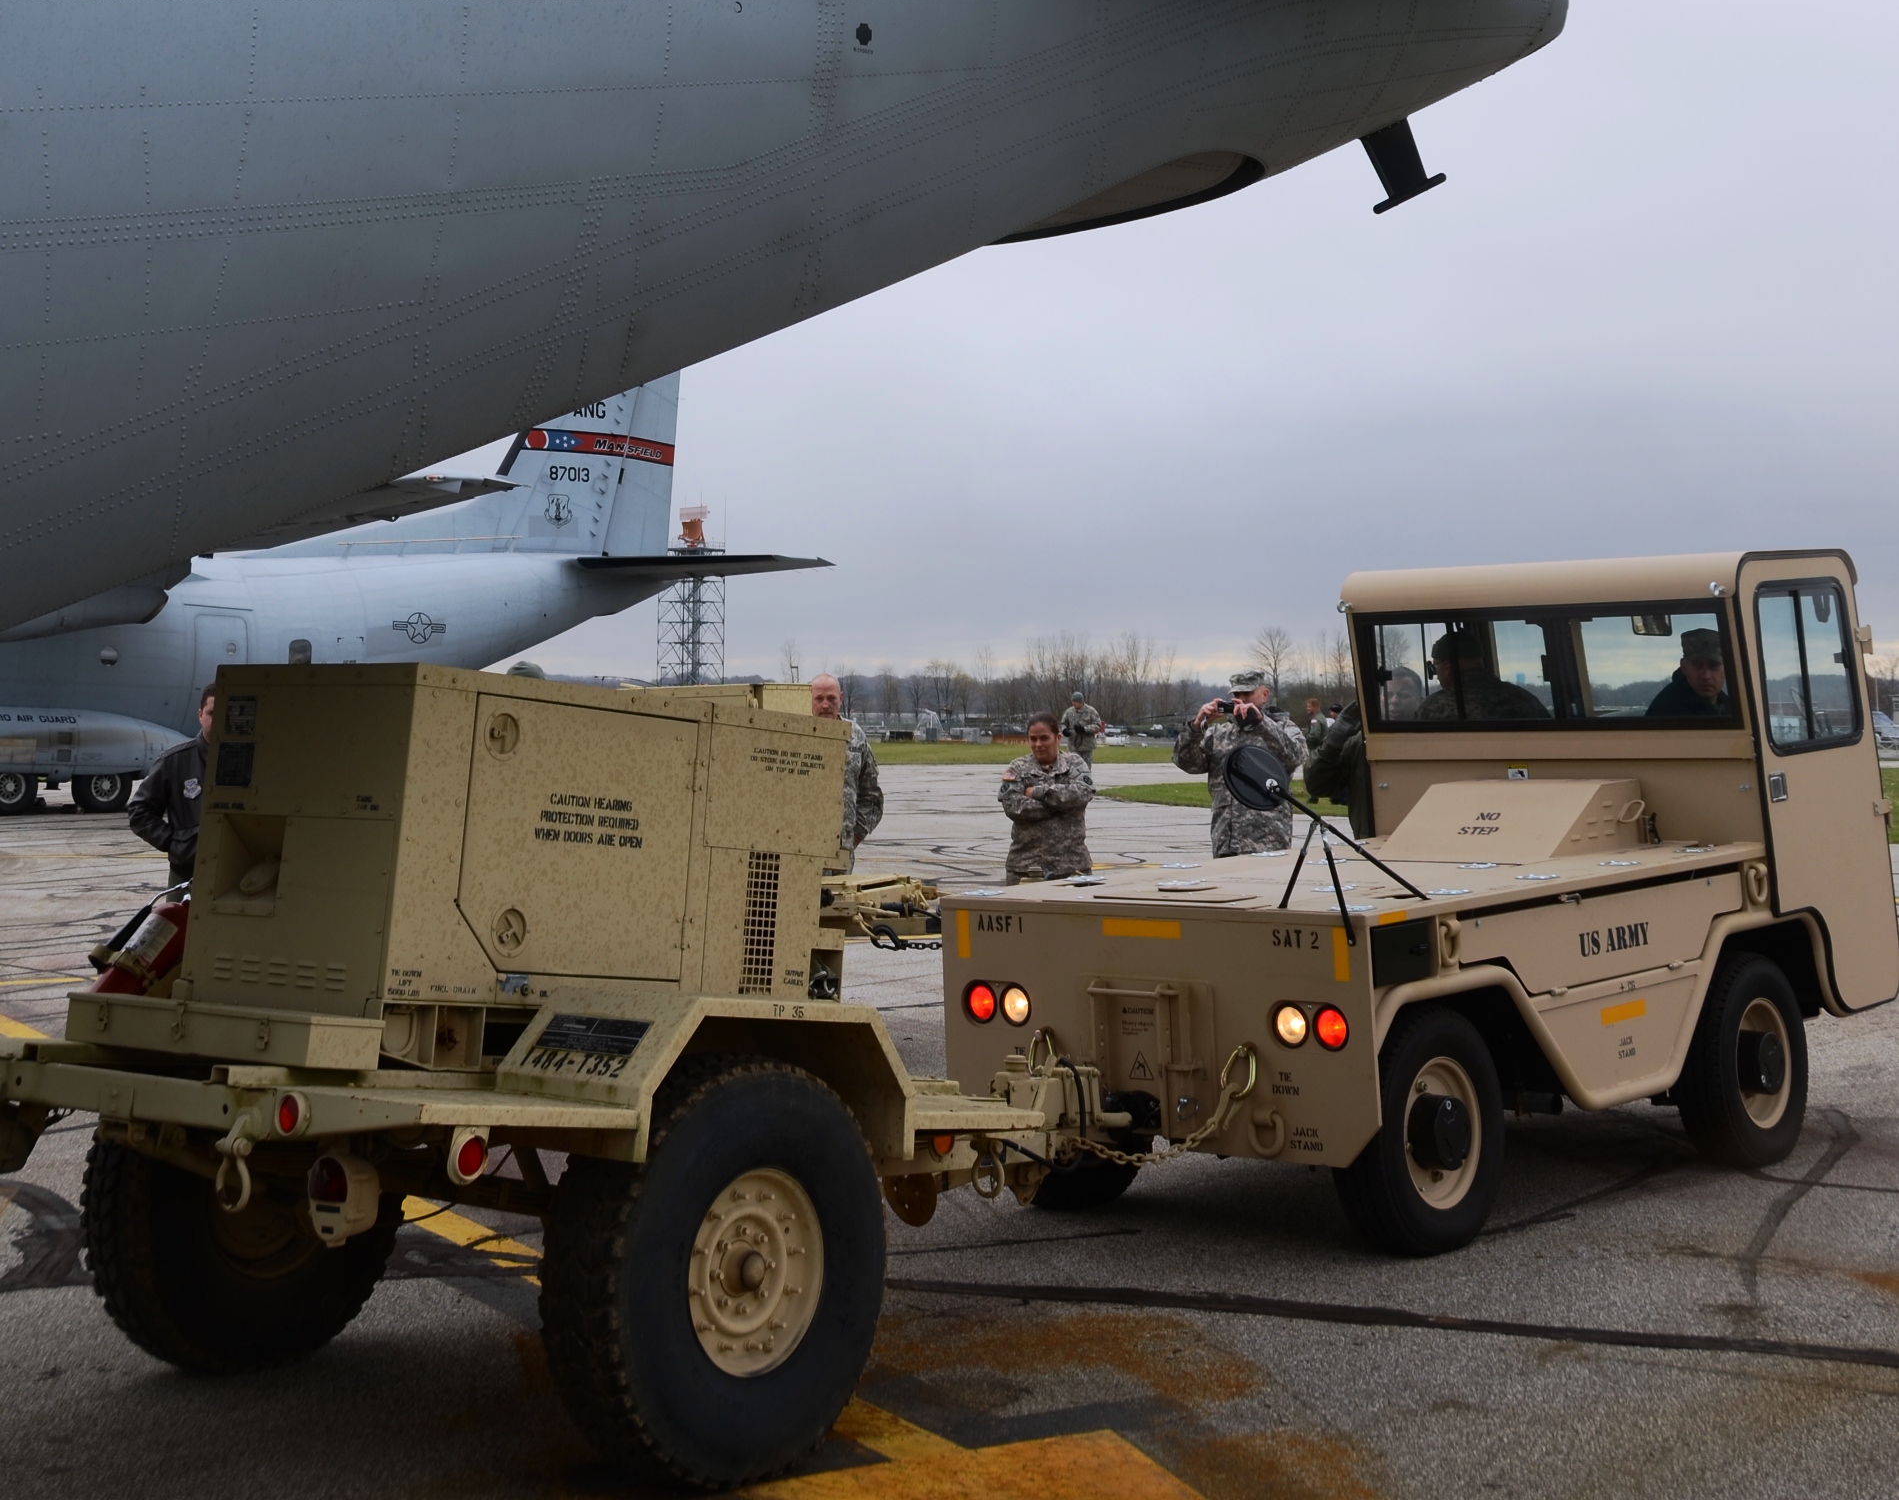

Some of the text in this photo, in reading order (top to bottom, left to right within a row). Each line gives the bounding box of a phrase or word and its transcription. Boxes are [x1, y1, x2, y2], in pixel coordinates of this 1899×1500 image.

[573, 401, 606, 419] ANG
[549, 465, 590, 483] 87013
[17, 714, 35, 723] AIR
[39, 715, 77, 724] GUARD
[753, 747, 779, 756] CAUTION
[803, 753, 823, 761] STAND
[779, 759, 798, 767] HEAVY
[550, 793, 633, 812] CAUTION HEARING
[540, 810, 639, 831] PROTECTION REQUIRED
[1475, 812, 1501, 821] NO
[1457, 826, 1500, 836] STEP
[534, 827, 643, 849] WHEN DOORS ARE OPEN
[978, 913, 1012, 933] AASF
[1272, 929, 1319, 950] SAT 2
[1578, 921, 1649, 957] US ARMY
[402, 969, 422, 978] DOWN
[430, 984, 477, 995] FUEL DRAIN
[773, 1003, 785, 1017] TP
[1127, 1007, 1154, 1015] CAUTION
[1619, 1035, 1633, 1047] JACK
[1014, 1046, 1026, 1056] TIE
[1618, 1047, 1636, 1060] STAND
[1278, 1071, 1292, 1082] TIE
[1272, 1084, 1300, 1096] DOWN
[1293, 1126, 1319, 1138] JACK
[1290, 1139, 1323, 1152] STAND
